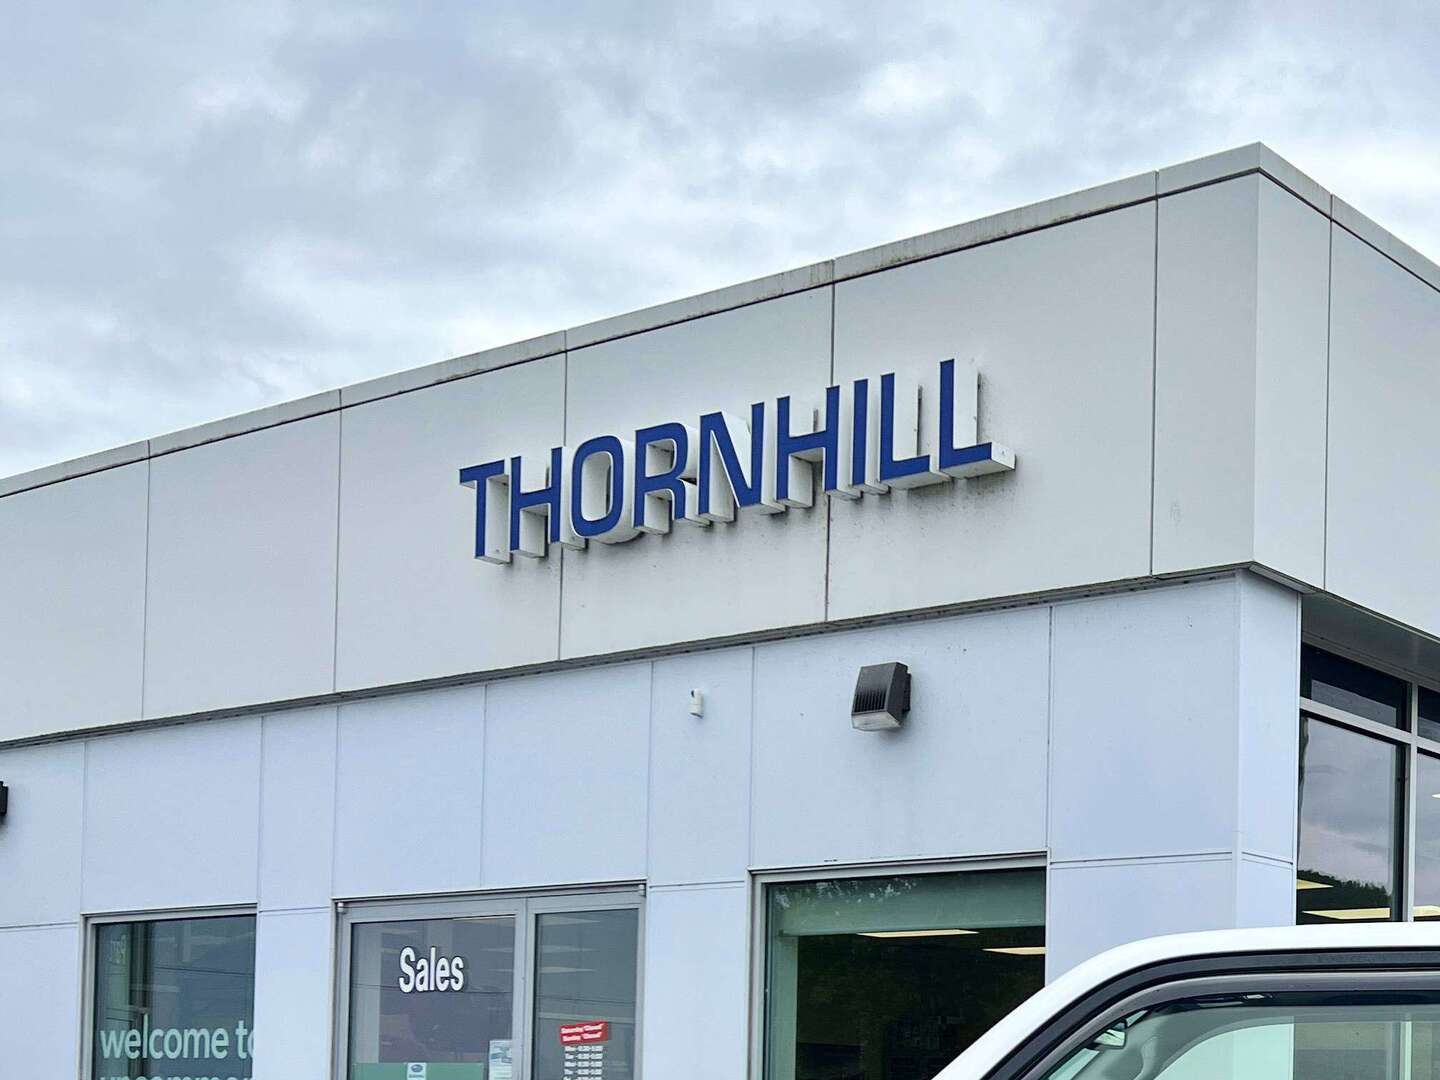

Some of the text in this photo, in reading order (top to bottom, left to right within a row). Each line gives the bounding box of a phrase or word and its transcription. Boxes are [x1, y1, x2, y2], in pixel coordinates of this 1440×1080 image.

[459, 359, 994, 558] THORNHILL
[399, 946, 465, 993] Sales
[99, 1013, 230, 1059] welcome
